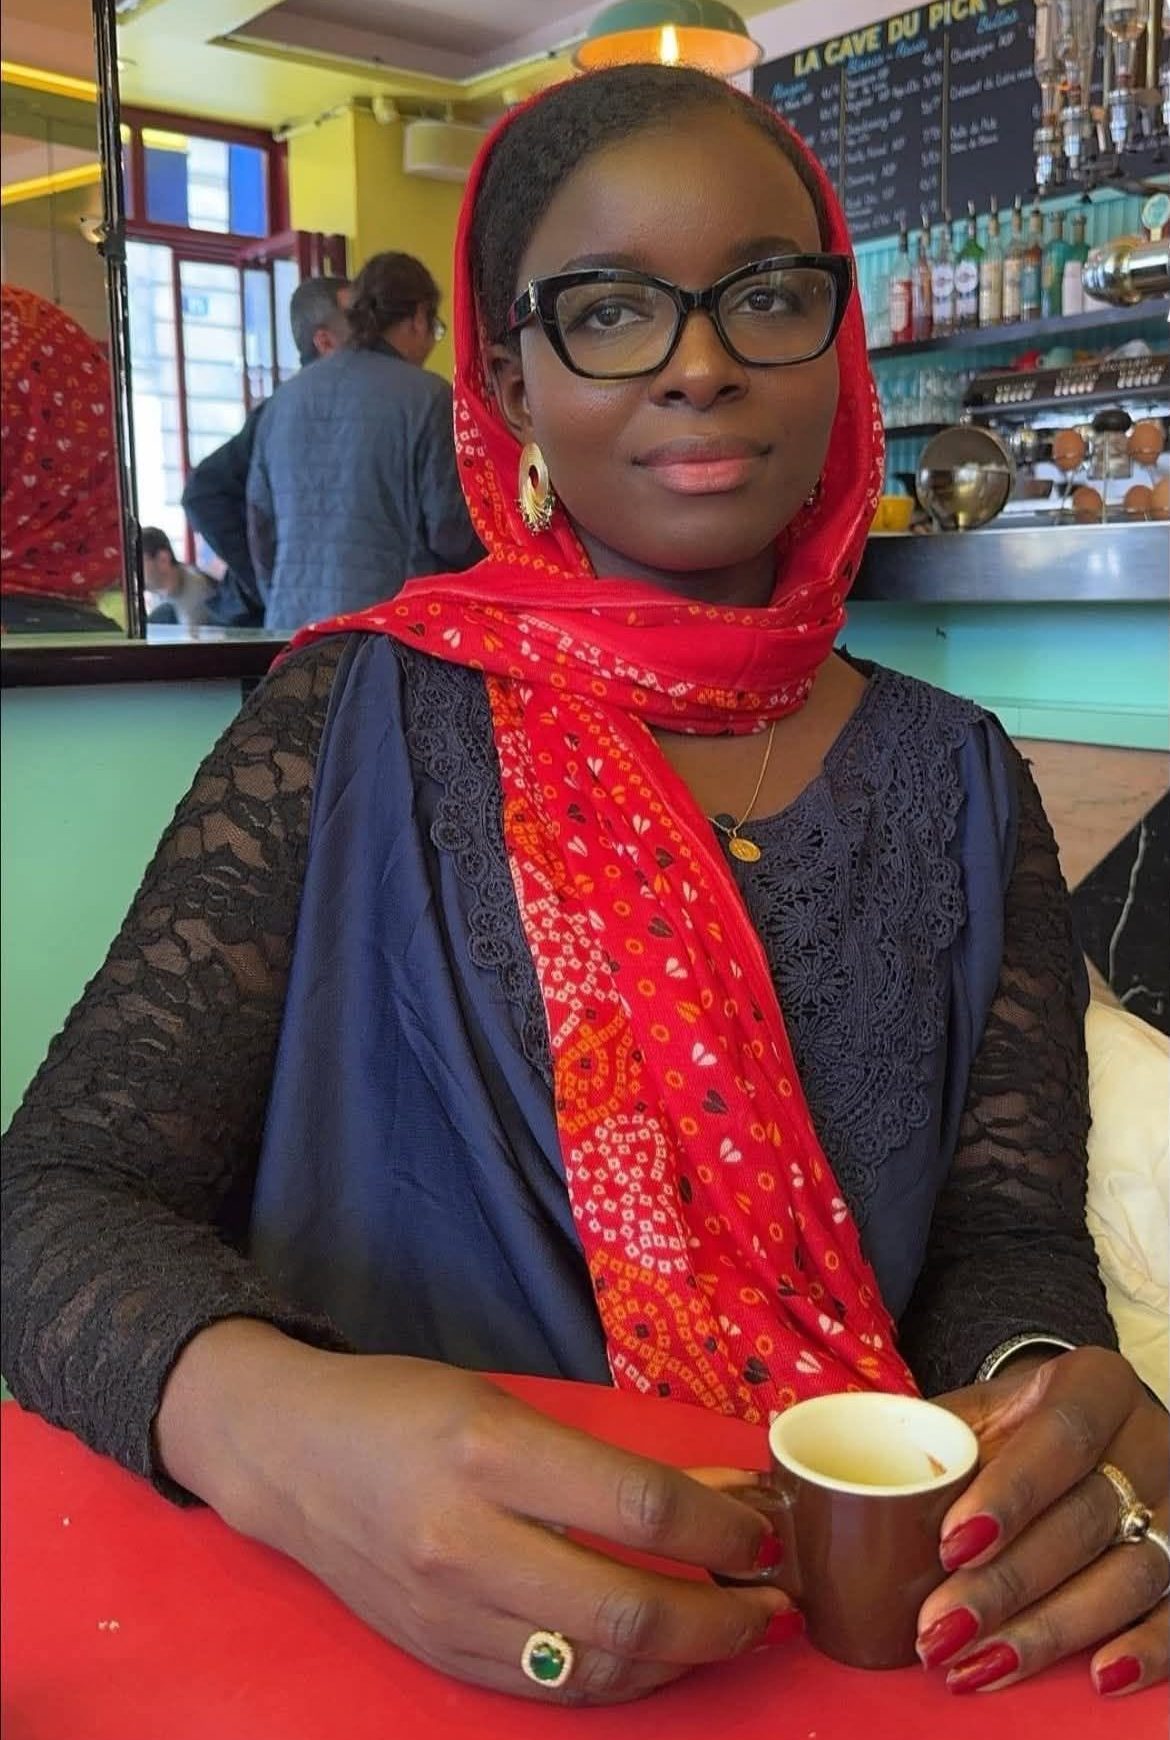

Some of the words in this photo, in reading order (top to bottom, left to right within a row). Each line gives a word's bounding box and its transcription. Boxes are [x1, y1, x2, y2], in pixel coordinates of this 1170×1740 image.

[794, 49, 821, 77] LA
[824, 26, 881, 65] CAVE
[888, 11, 920, 44] DU
[929, 0, 986, 31] PICK
